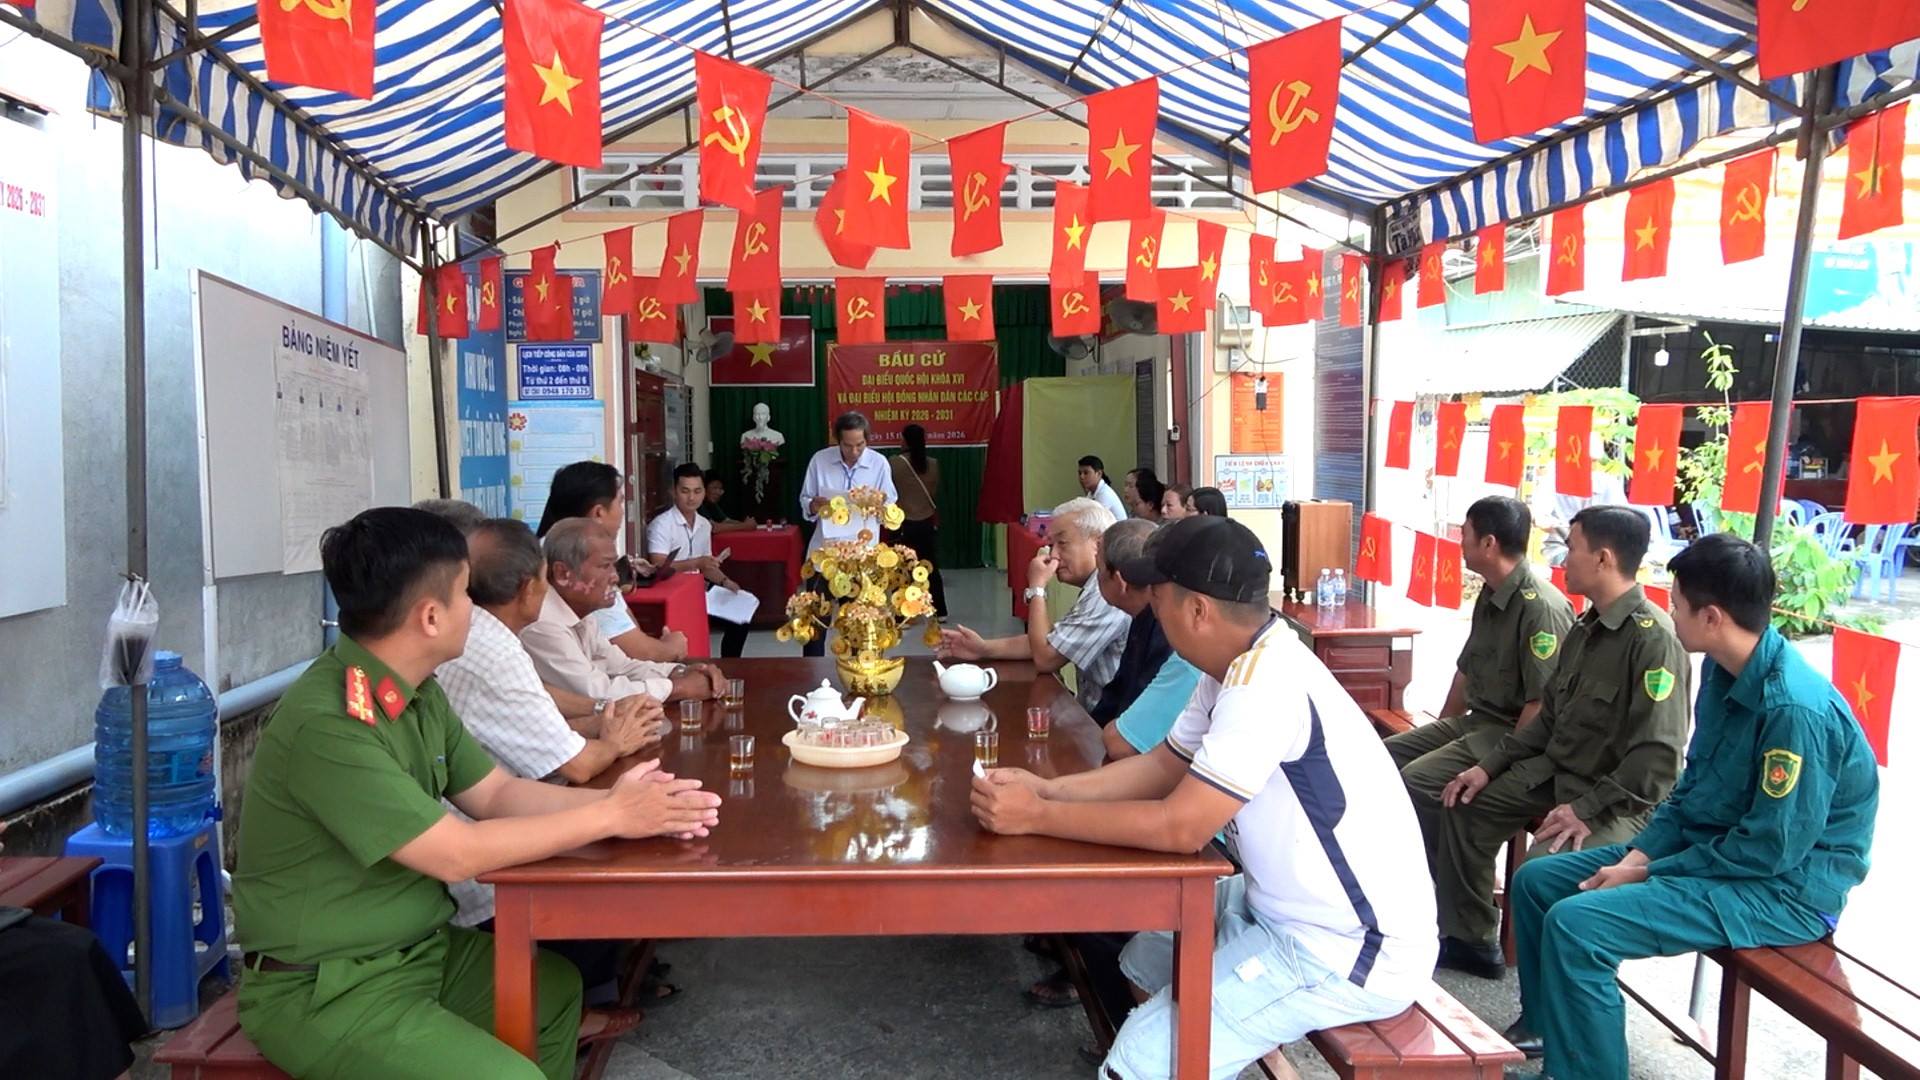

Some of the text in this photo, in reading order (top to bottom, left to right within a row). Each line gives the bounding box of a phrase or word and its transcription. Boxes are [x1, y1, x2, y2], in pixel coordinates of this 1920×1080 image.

[283, 319, 360, 369] BẢNG NIÊM YẾT
[879, 349, 946, 367] BẦU CỬ
[862, 373, 875, 389] ĐẠI
[876, 371, 894, 385] BIỂU
[895, 370, 916, 386] QUỐC
[916, 373, 930, 388] HỘI
[837, 391, 848, 403] VÀ
[849, 392, 862, 406] ĐẠI
[863, 390, 881, 403] BIỂU
[882, 391, 895, 406] HỘI
[896, 389, 917, 403] ĐỒNG
[917, 390, 940, 403] NHÂN
[941, 390, 957, 403] DÂN
[958, 390, 972, 403] CÁC
[874, 409, 898, 424] NHIỆM
